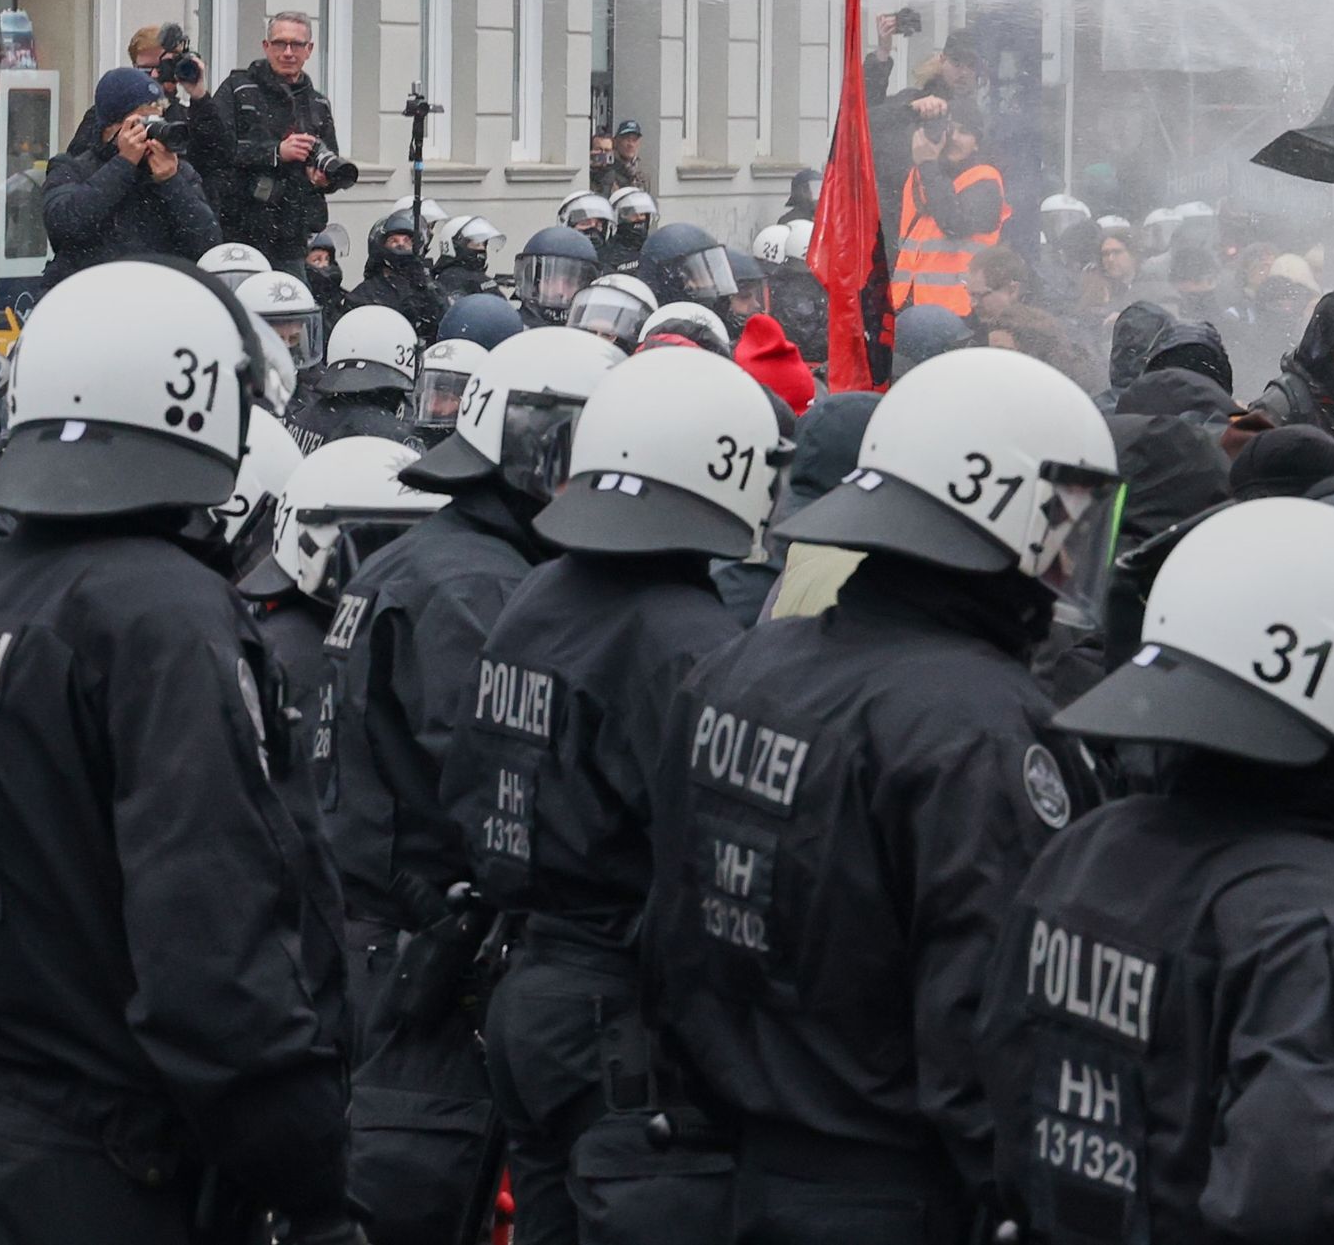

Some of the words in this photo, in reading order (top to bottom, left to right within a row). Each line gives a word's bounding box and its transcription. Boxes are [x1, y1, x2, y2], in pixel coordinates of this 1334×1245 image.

[165, 347, 219, 413] 31
[394, 344, 415, 368] 32
[462, 378, 495, 428] 31
[707, 435, 757, 492] 31
[947, 452, 1025, 523] 31
[1251, 622, 1334, 700] 31
[475, 659, 554, 738] POLIZEI
[691, 705, 810, 806] POLIZEI
[498, 768, 525, 819] HH
[1027, 919, 1157, 1043] POLIZEI
[1057, 1059, 1122, 1127] HH
